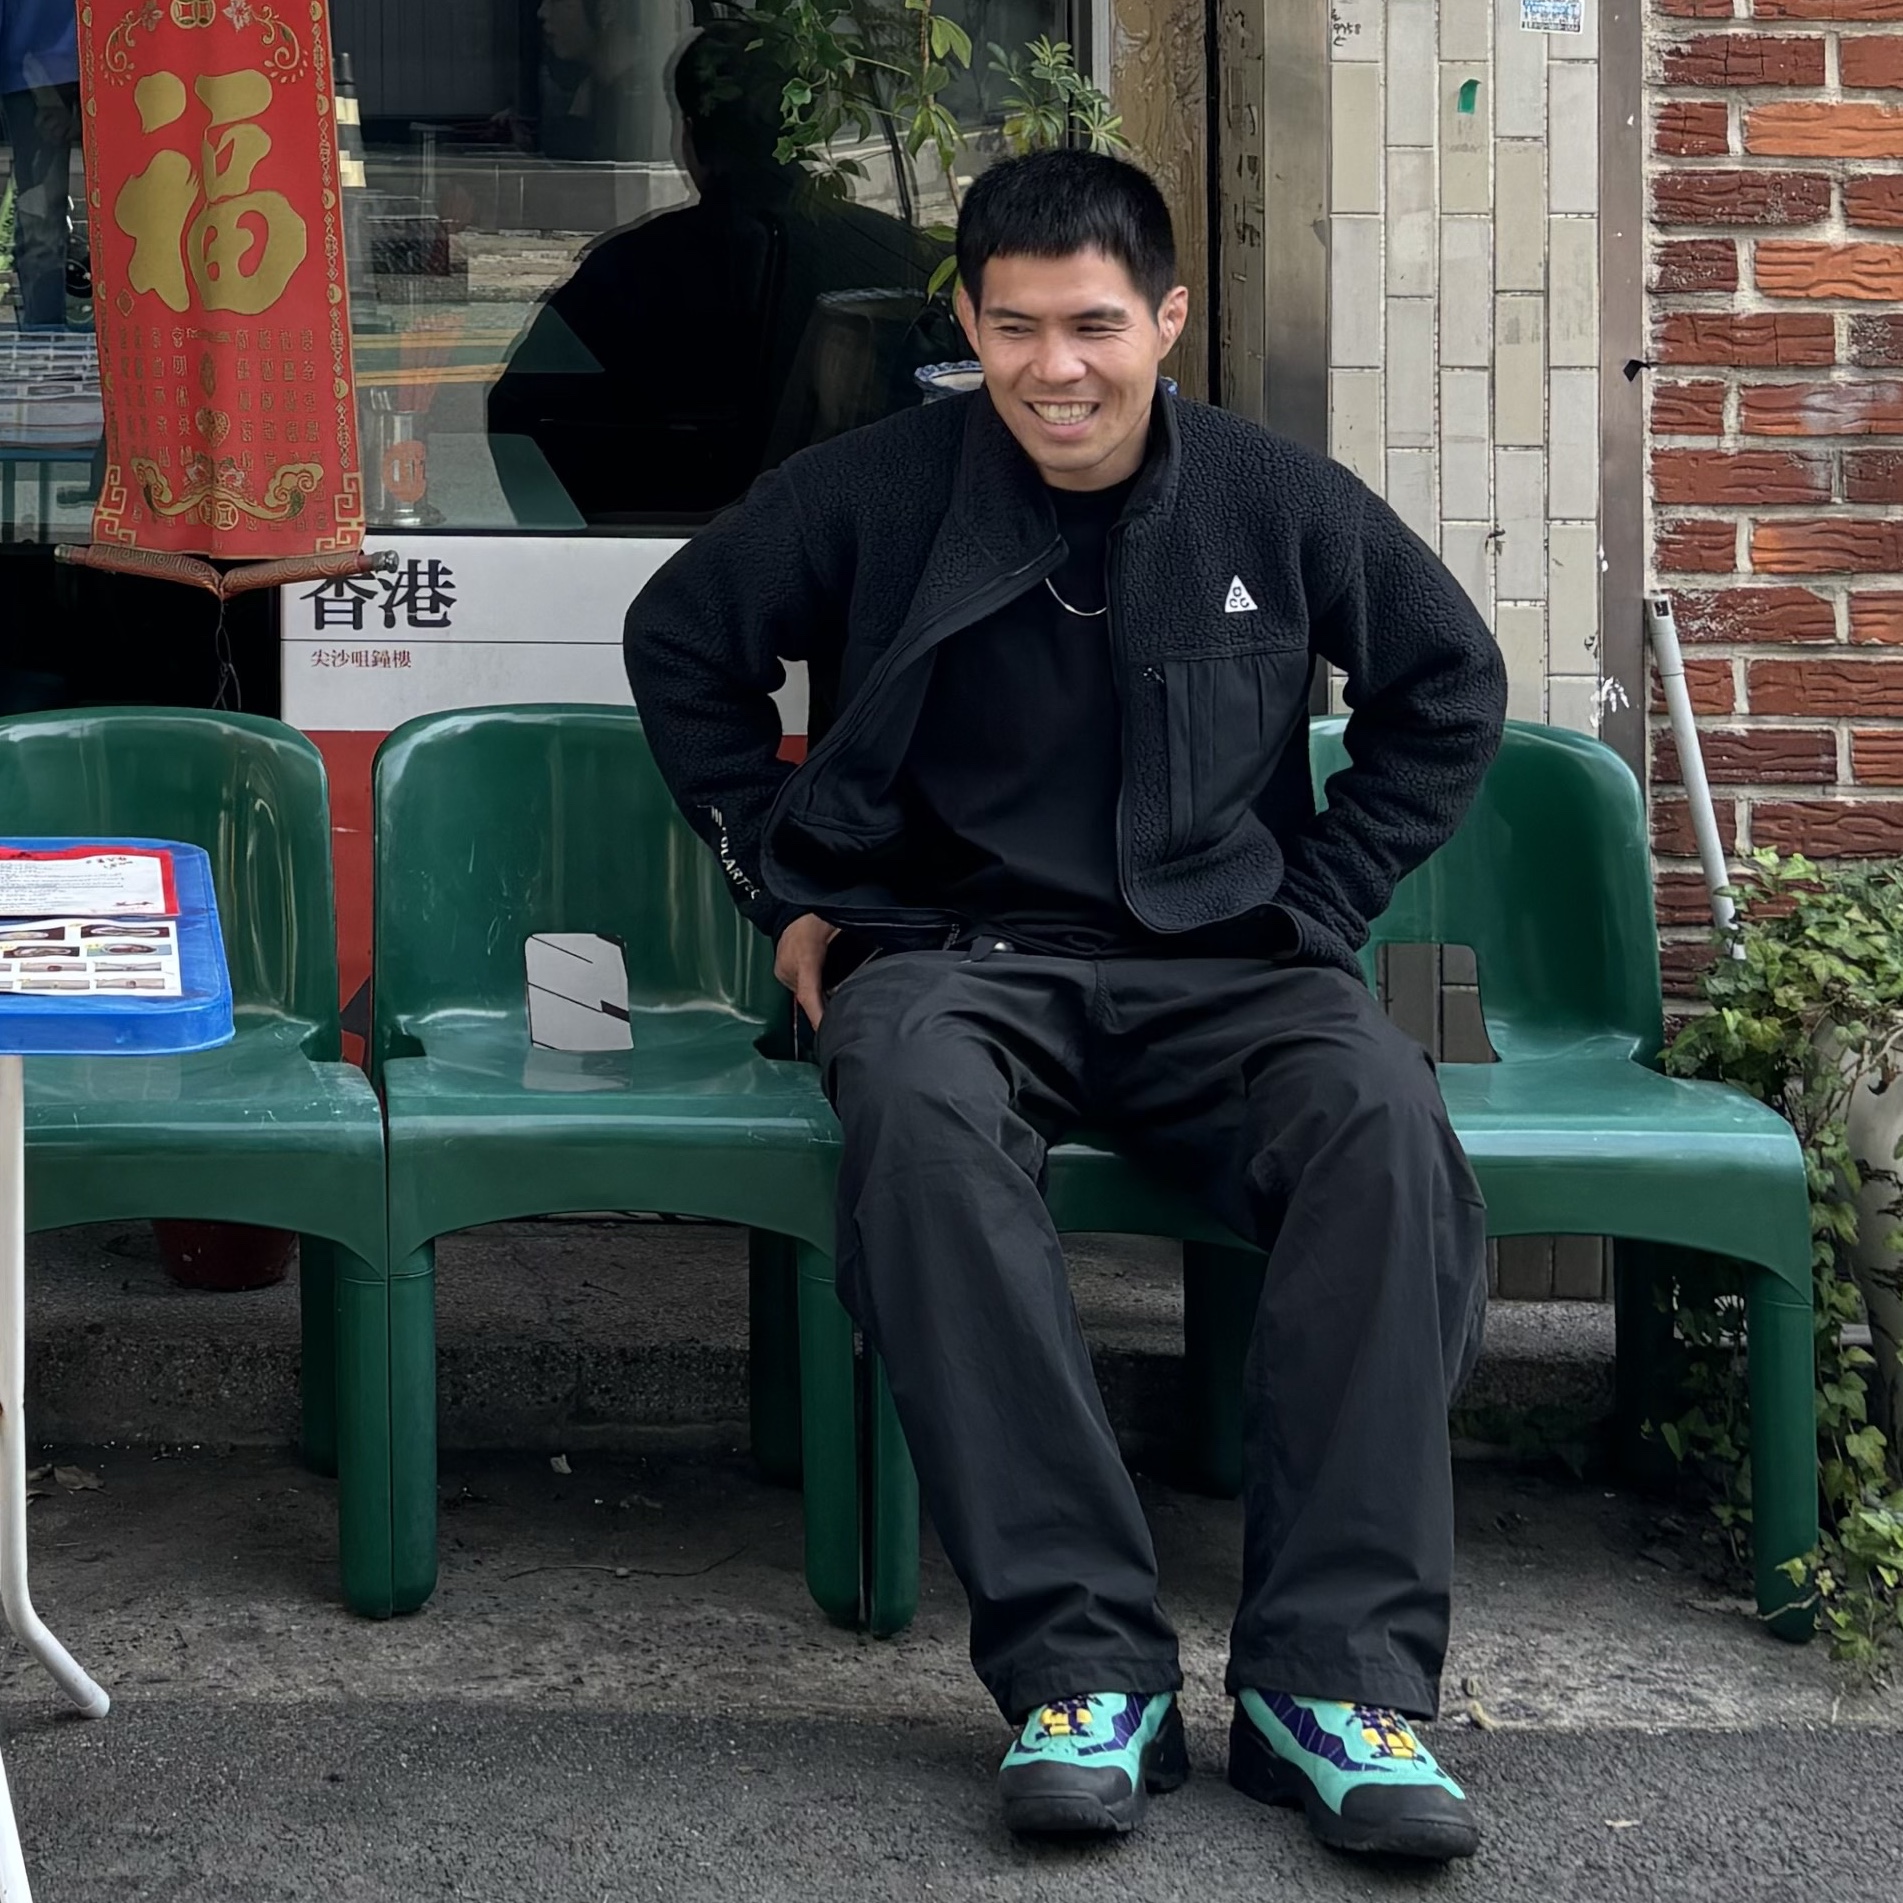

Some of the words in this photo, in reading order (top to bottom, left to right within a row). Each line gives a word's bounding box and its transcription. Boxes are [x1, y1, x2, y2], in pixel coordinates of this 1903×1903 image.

[115, 70, 307, 314] 福
[300, 559, 457, 630] 香港
[721, 827, 760, 899] OLARTC
